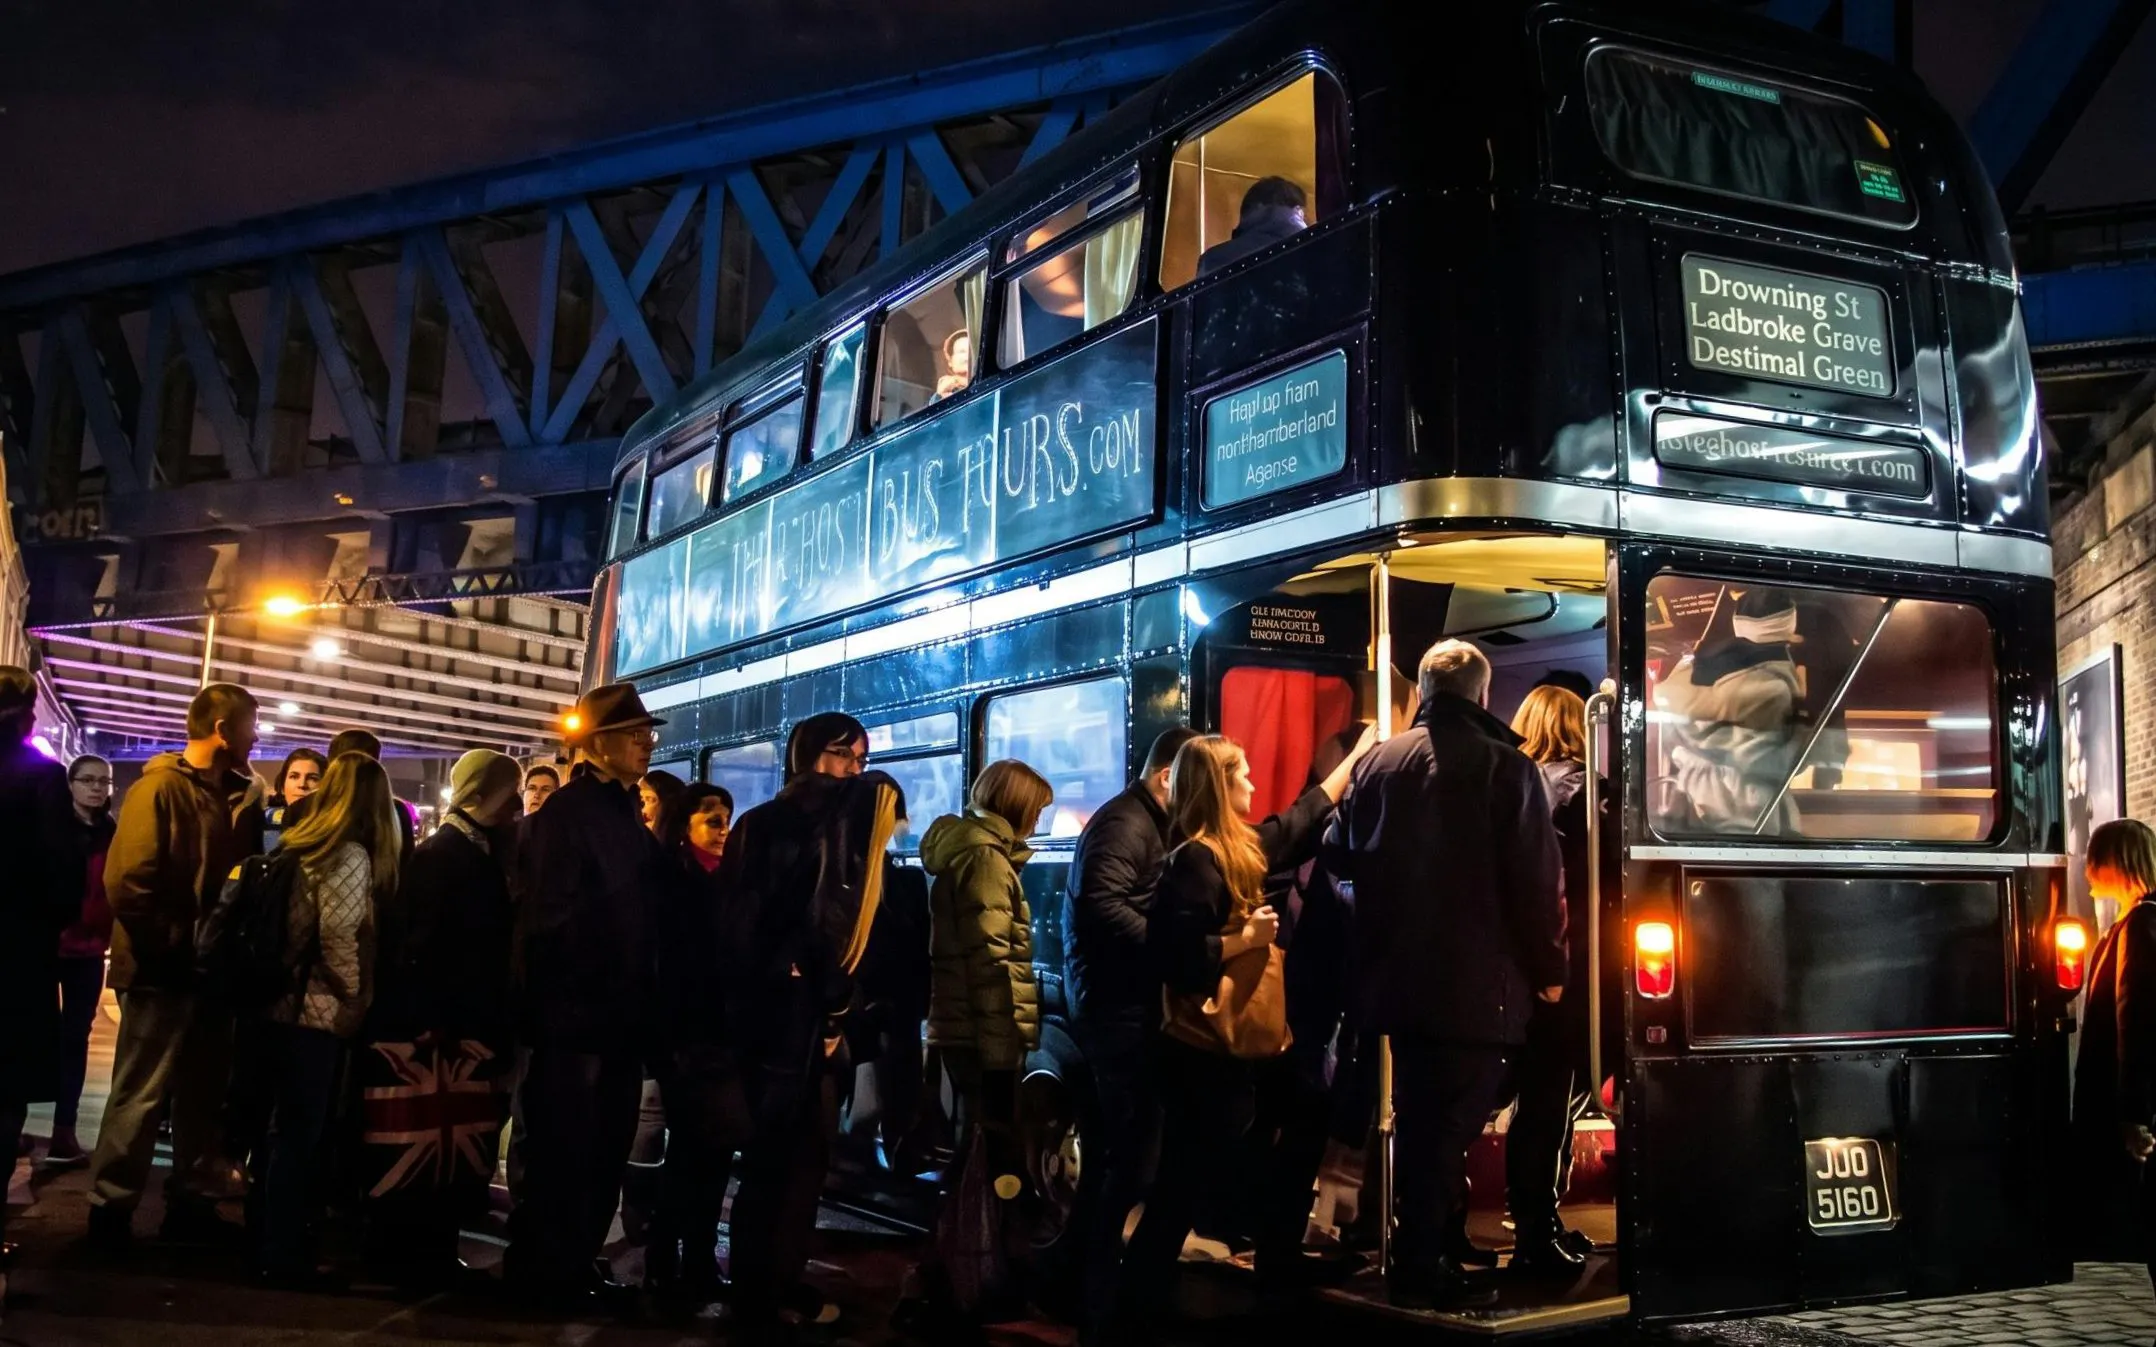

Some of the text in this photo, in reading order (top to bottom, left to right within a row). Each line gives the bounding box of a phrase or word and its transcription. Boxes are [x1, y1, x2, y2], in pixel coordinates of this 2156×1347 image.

[1698, 268, 1861, 321] Drowning St
[1690, 302, 1882, 356] Ladbroke Grave
[1693, 336, 1885, 389] Destimal Green
[879, 458, 943, 563] BUS
[1817, 1185, 1879, 1219] 5160
